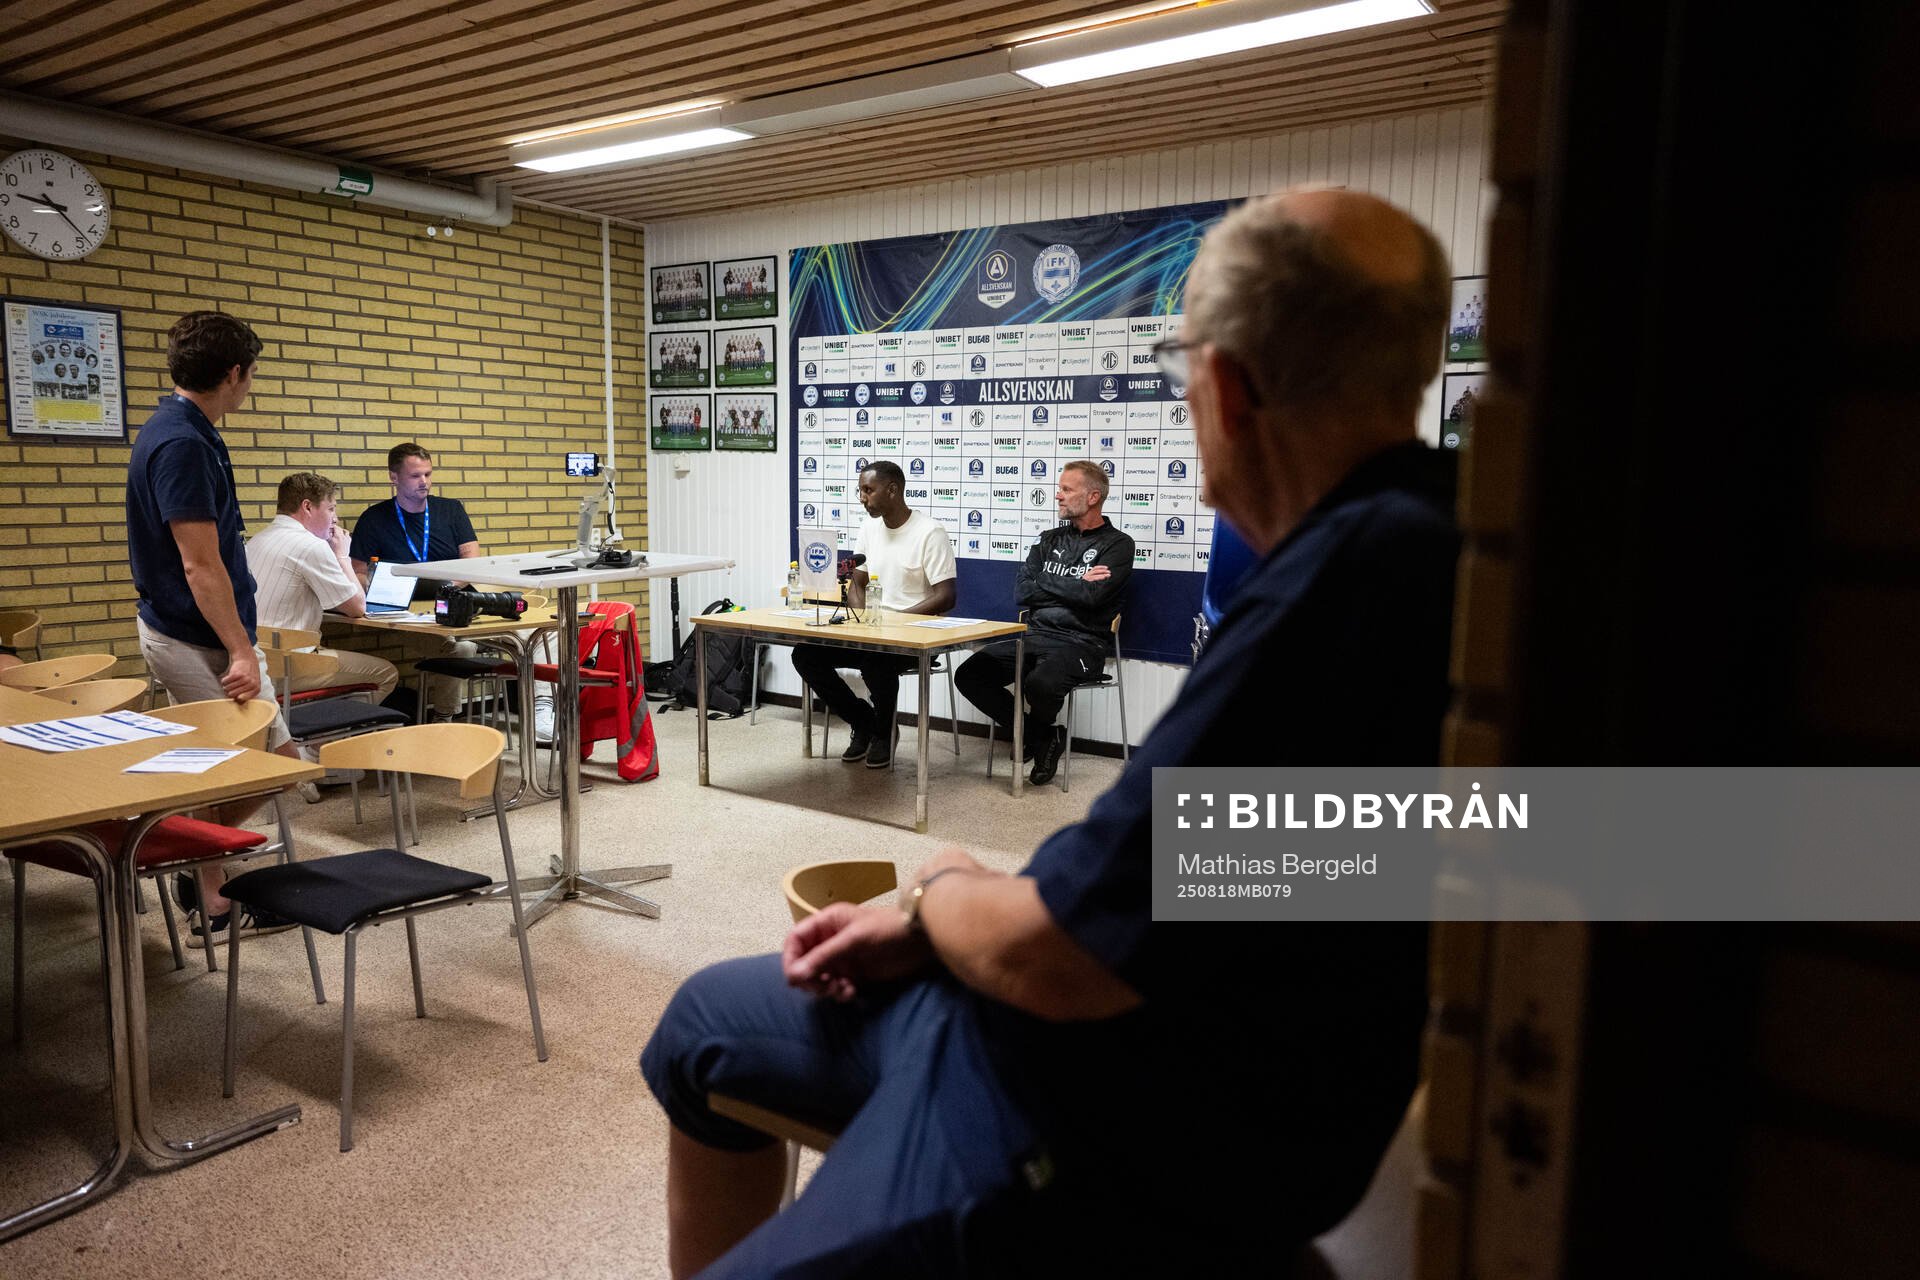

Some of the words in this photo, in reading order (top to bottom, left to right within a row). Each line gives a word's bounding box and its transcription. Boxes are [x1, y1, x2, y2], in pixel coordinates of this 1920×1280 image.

[21, 160, 32, 174] 11
[41, 158, 54, 171] 12
[5, 174, 18, 186] 10
[84, 184, 94, 196] 2
[0, 194, 10, 206] 9
[10, 216, 20, 228] 8
[88, 224, 98, 236] 4
[28, 232, 38, 243] 7
[52, 241, 62, 252] 6
[75, 237, 84, 249] 5
[1047, 257, 1066, 267] IFK
[981, 282, 1012, 290] ALLSVENSKAN
[1061, 328, 1091, 336] UNIBET
[1131, 324, 1163, 333] UNIBET
[936, 335, 961, 343] UNIBET
[997, 331, 1024, 340] UNIBET
[825, 341, 848, 349] UNIBET
[879, 338, 902, 346] UNIBET
[1129, 380, 1162, 389] UNIBET
[823, 389, 849, 397] UNIBET
[876, 388, 904, 396] UNIBET
[979, 380, 1073, 401] ALLSVENSKAN
[1059, 438, 1087, 446] UNIBET
[993, 490, 1020, 498] UNIBET
[1125, 493, 1154, 501] UNIBET
